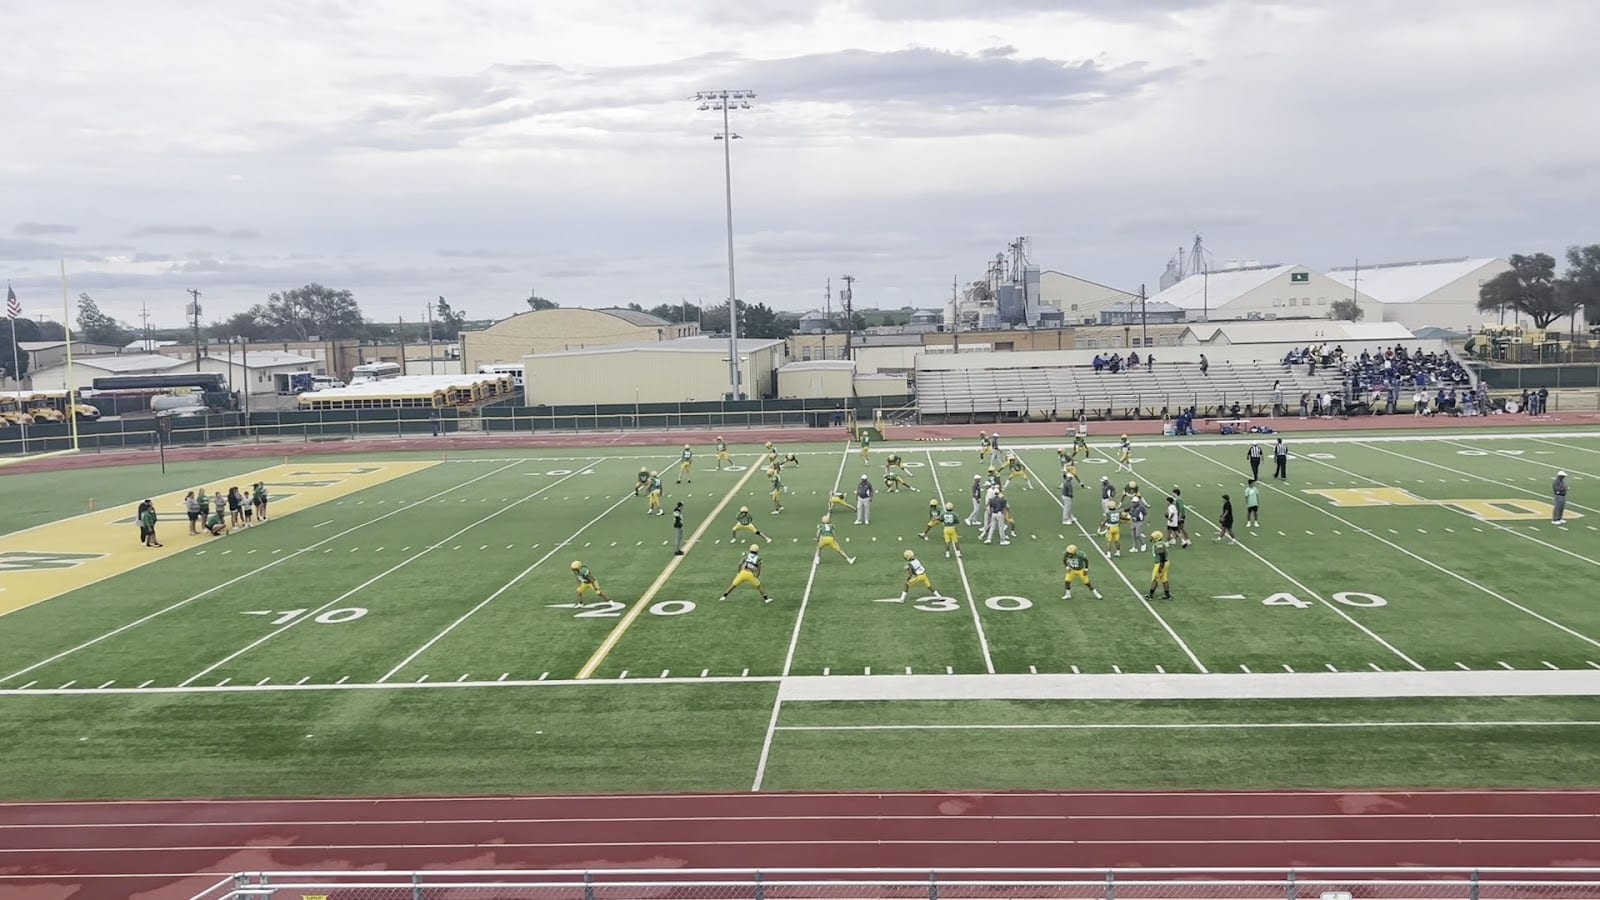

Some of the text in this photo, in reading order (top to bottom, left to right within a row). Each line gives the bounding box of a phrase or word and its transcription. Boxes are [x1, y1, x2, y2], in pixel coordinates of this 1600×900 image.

[573, 600, 697, 618] 20
[912, 595, 1034, 612] 30
[1262, 591, 1388, 609] 40
[270, 607, 369, 625] 10
